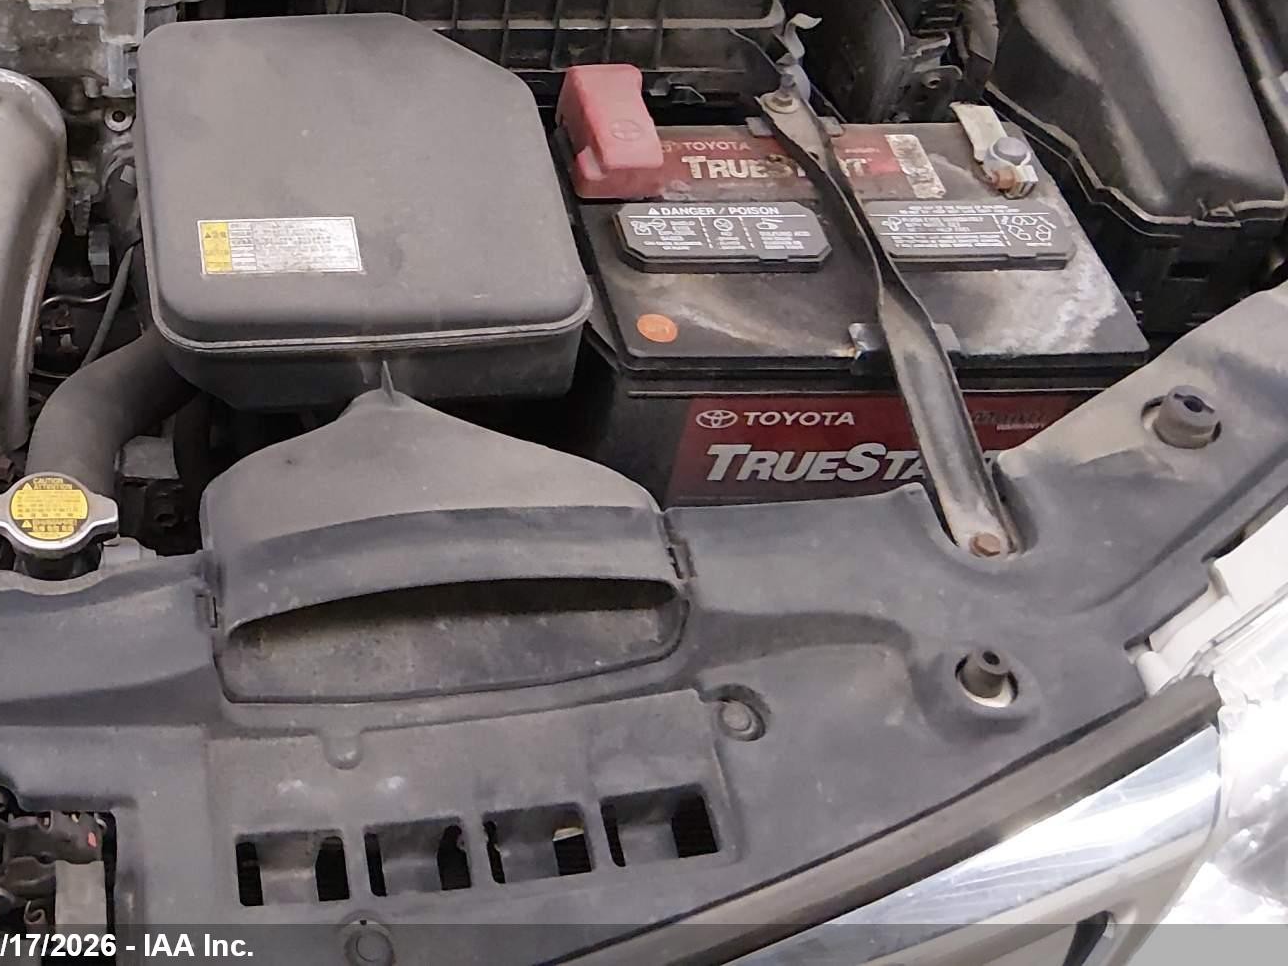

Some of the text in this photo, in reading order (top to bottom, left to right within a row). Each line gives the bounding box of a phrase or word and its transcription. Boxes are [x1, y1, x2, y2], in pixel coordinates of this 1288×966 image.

[681, 141, 751, 152] TOYOTA
[660, 206, 715, 216] DANGER
[728, 206, 780, 216] POISON
[744, 410, 856, 427] TOYOTA
